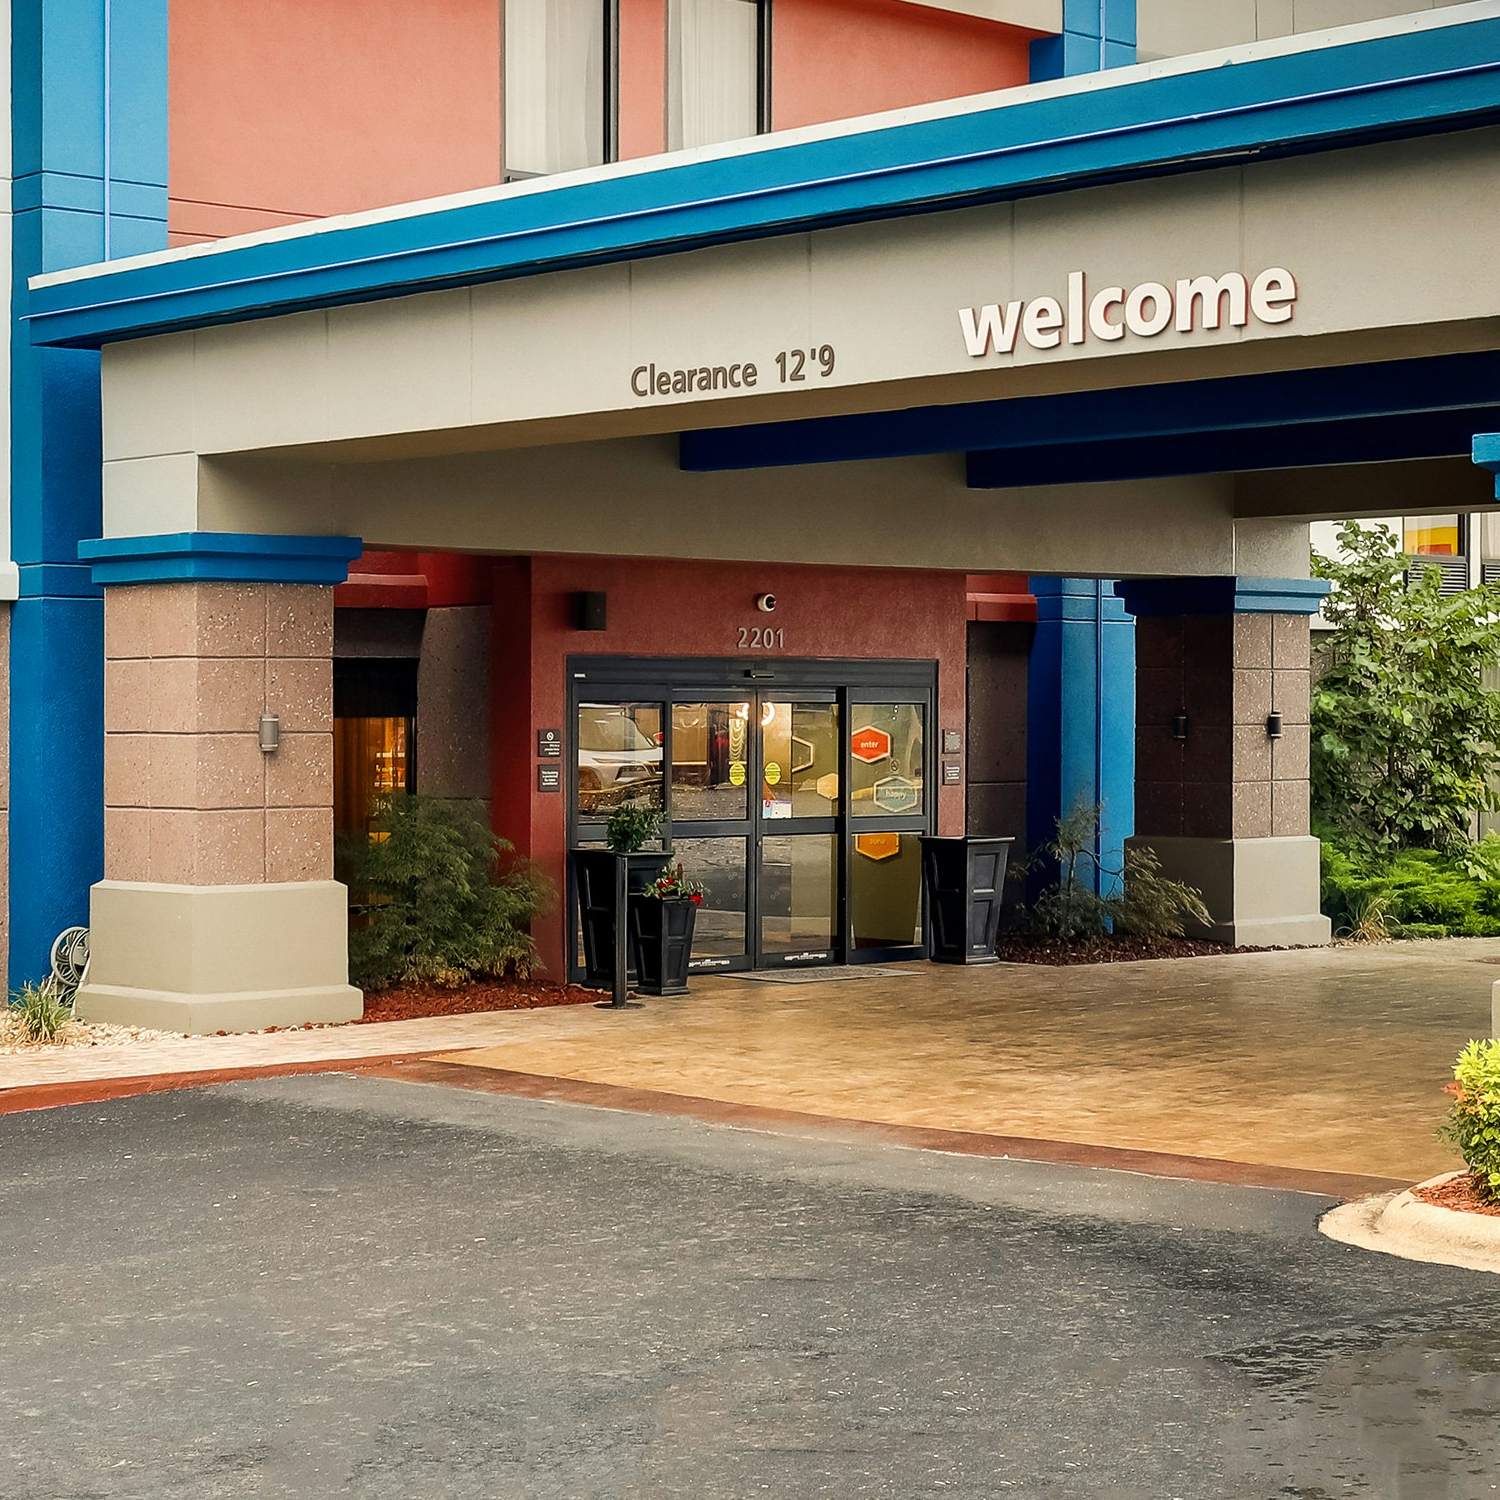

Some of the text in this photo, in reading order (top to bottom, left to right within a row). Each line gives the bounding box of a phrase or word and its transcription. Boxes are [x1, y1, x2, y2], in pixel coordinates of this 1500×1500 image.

[958, 266, 1298, 357] welcome
[631, 344, 836, 397] Clearance 12'9
[737, 627, 784, 649] 2201
[860, 740, 879, 749] enter
